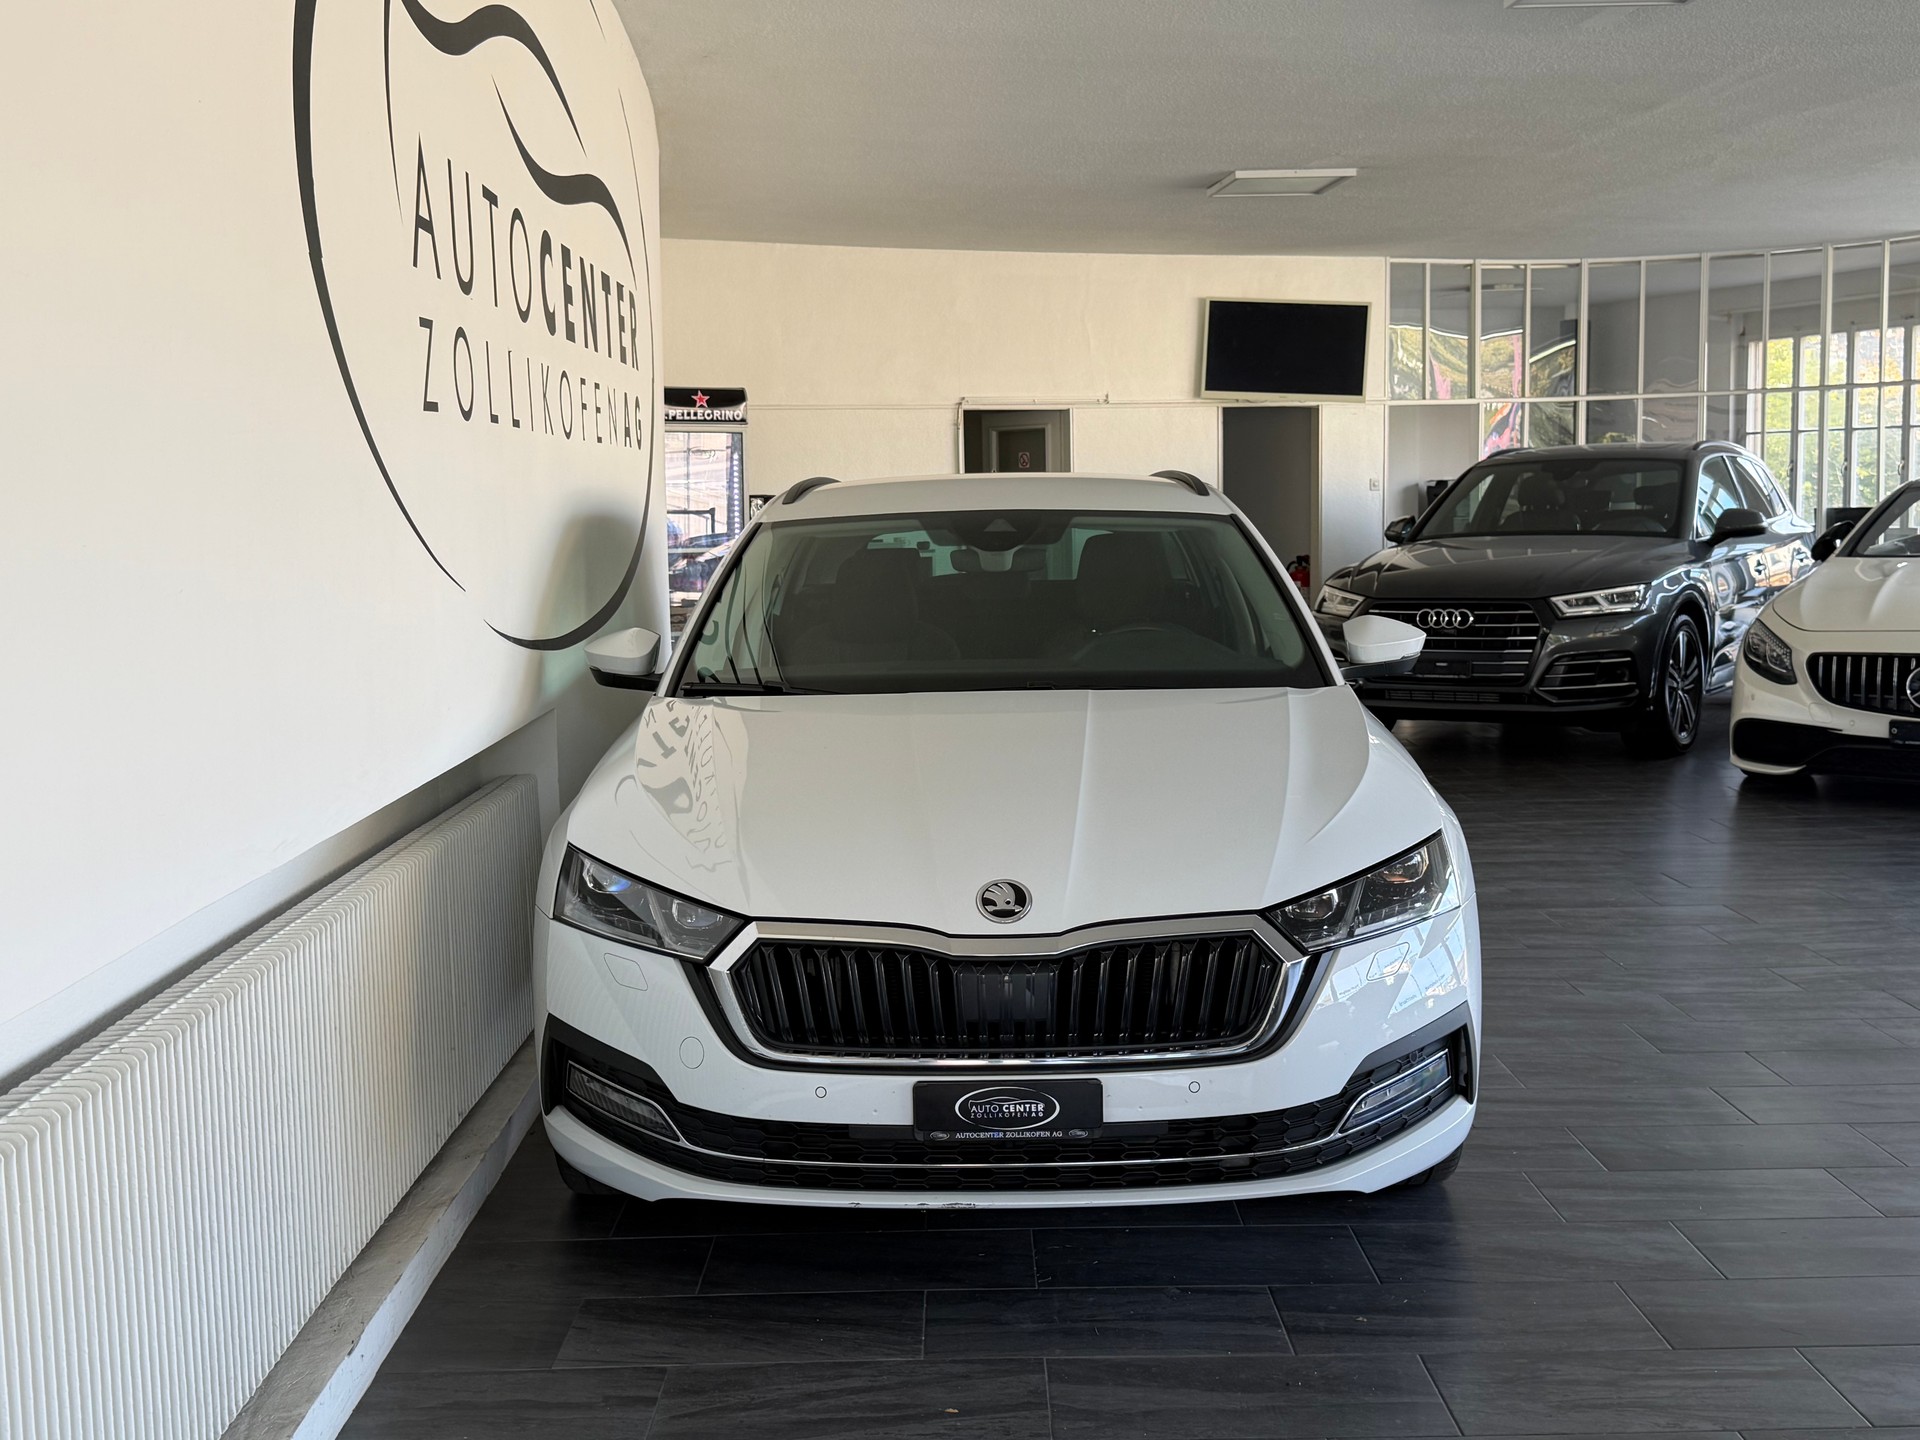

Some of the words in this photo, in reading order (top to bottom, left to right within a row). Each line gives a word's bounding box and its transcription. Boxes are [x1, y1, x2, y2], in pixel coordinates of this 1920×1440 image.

[970, 1104, 999, 1113] AUTO
[1002, 1103, 1044, 1112] CENTER
[955, 1131, 1004, 1139] AUTOCENTER
[1005, 1130, 1050, 1138] ZOLLIKOFEN
[1052, 1130, 1063, 1138] AG
